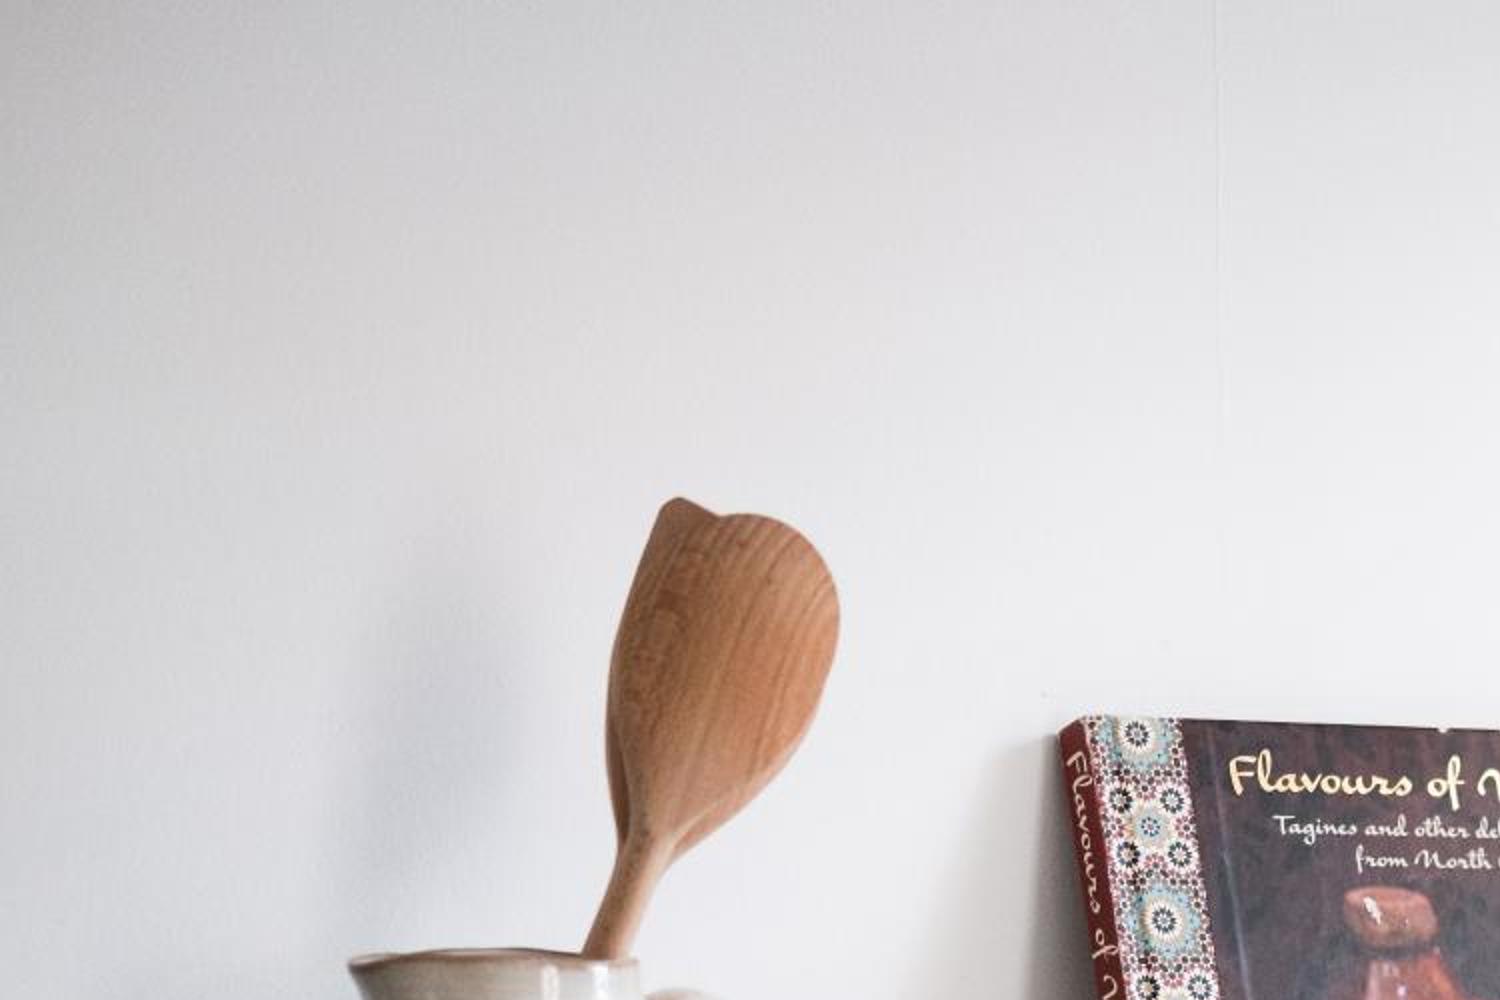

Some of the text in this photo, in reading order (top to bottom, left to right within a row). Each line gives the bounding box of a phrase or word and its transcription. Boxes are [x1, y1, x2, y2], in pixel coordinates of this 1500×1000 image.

[1228, 749, 1412, 796] Flavours
[1427, 755, 1465, 811] of
[1272, 815, 1357, 846] Tagines
[1365, 816, 1407, 839] and
[1415, 817, 1470, 839] other
[1066, 751, 1100, 914] Flavours
[1092, 928, 1119, 960] of
[1355, 846, 1407, 873] from
[1414, 849, 1493, 871] North
